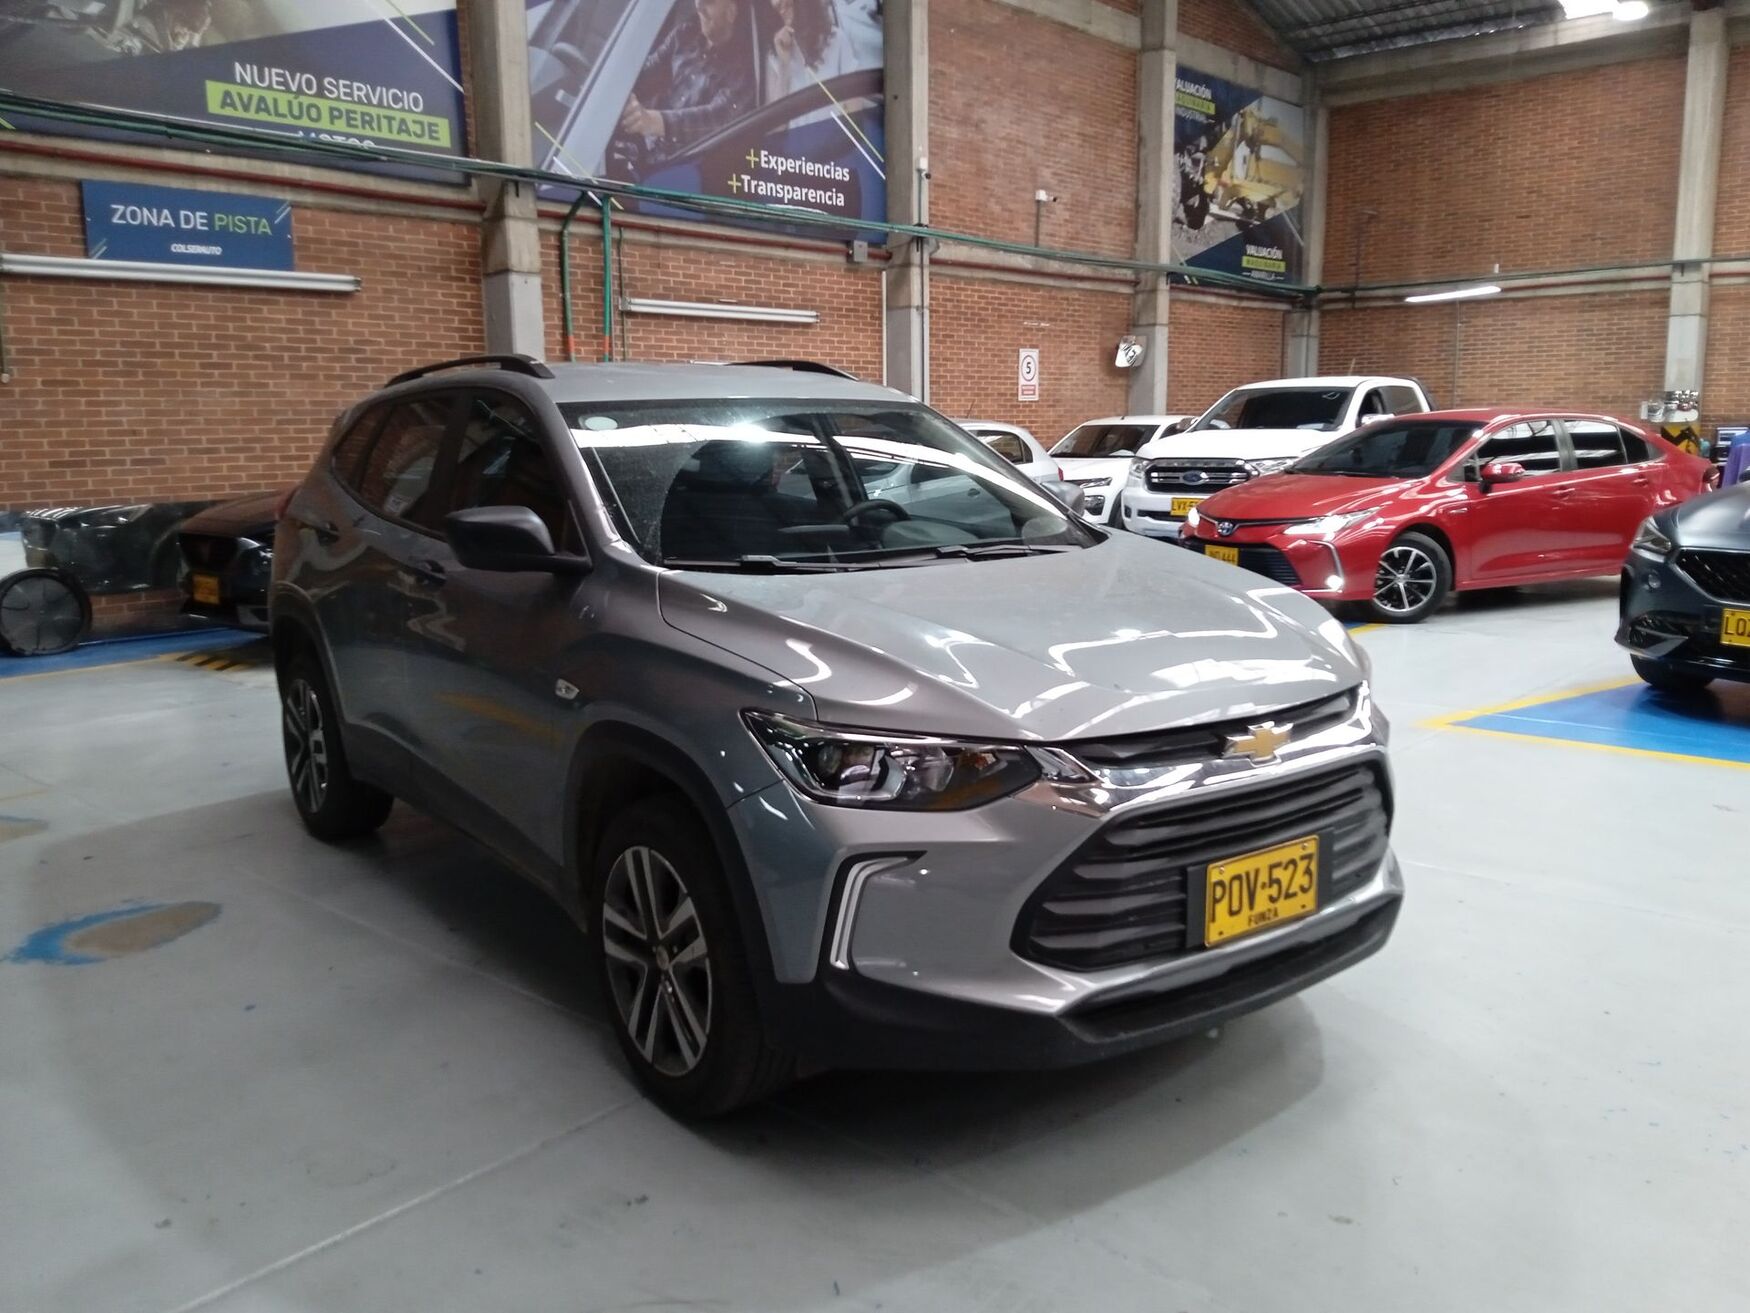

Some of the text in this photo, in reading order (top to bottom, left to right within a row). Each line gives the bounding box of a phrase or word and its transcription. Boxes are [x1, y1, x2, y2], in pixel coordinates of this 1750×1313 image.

[234, 62, 423, 112] NUEVO SERVICIO
[1175, 79, 1212, 99] ALUACIÓN
[220, 90, 322, 123] AVALÚO
[328, 106, 441, 141] PERITAJE
[110, 204, 272, 236] ZONA DE PISTA
[1025, 361, 1032, 375] 5
